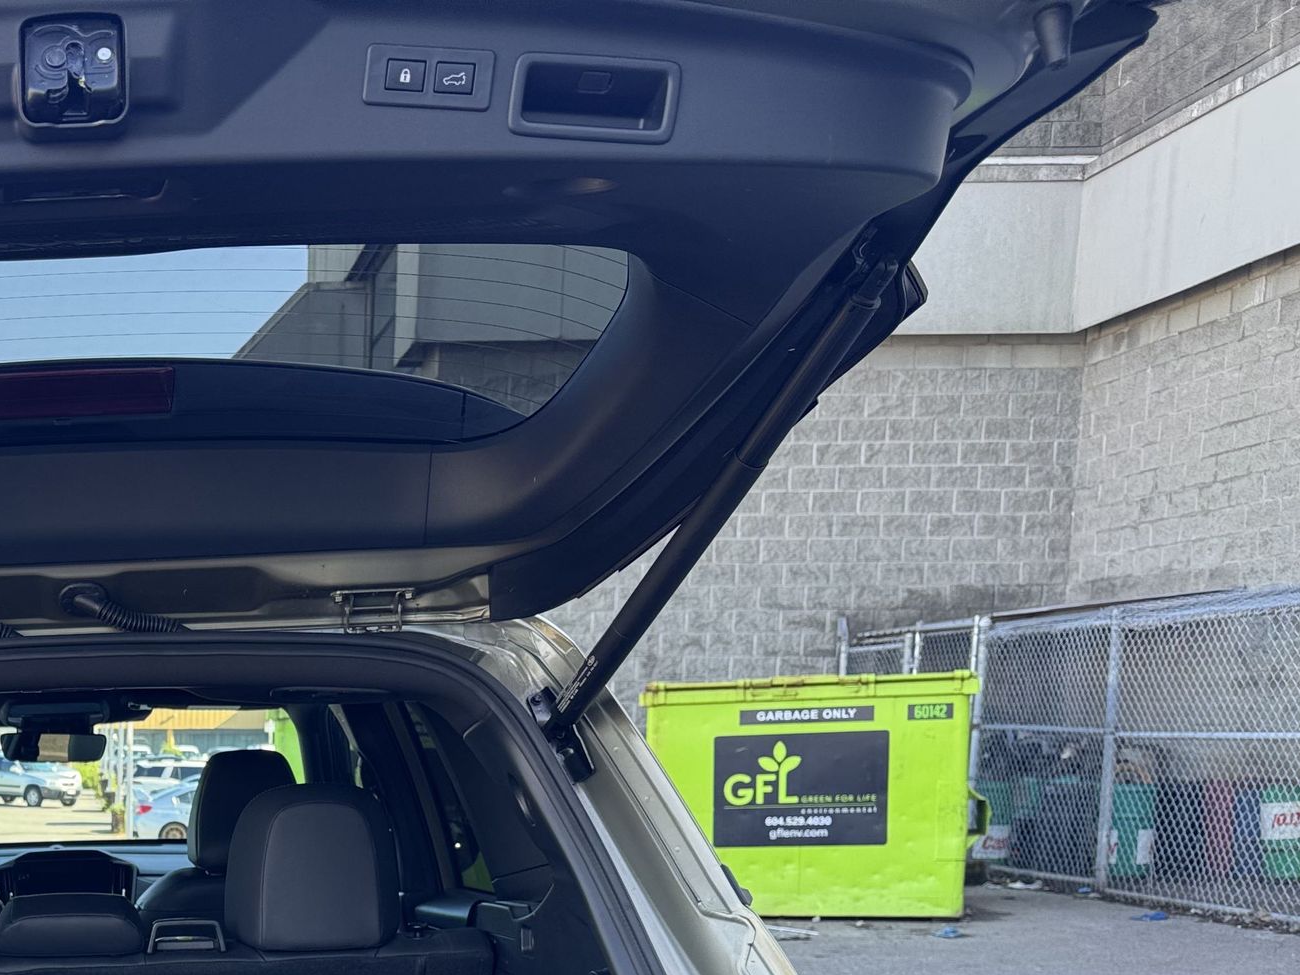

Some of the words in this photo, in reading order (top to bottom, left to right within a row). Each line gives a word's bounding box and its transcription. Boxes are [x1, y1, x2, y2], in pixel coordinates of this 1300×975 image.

[756, 709, 819, 721] GARBAGE
[822, 707, 857, 719] ONLY
[913, 704, 948, 719] 60142
[723, 766, 800, 806] GFL
[800, 794, 833, 804] GREEN
[835, 793, 854, 803] FOR
[856, 793, 878, 803] LIFE
